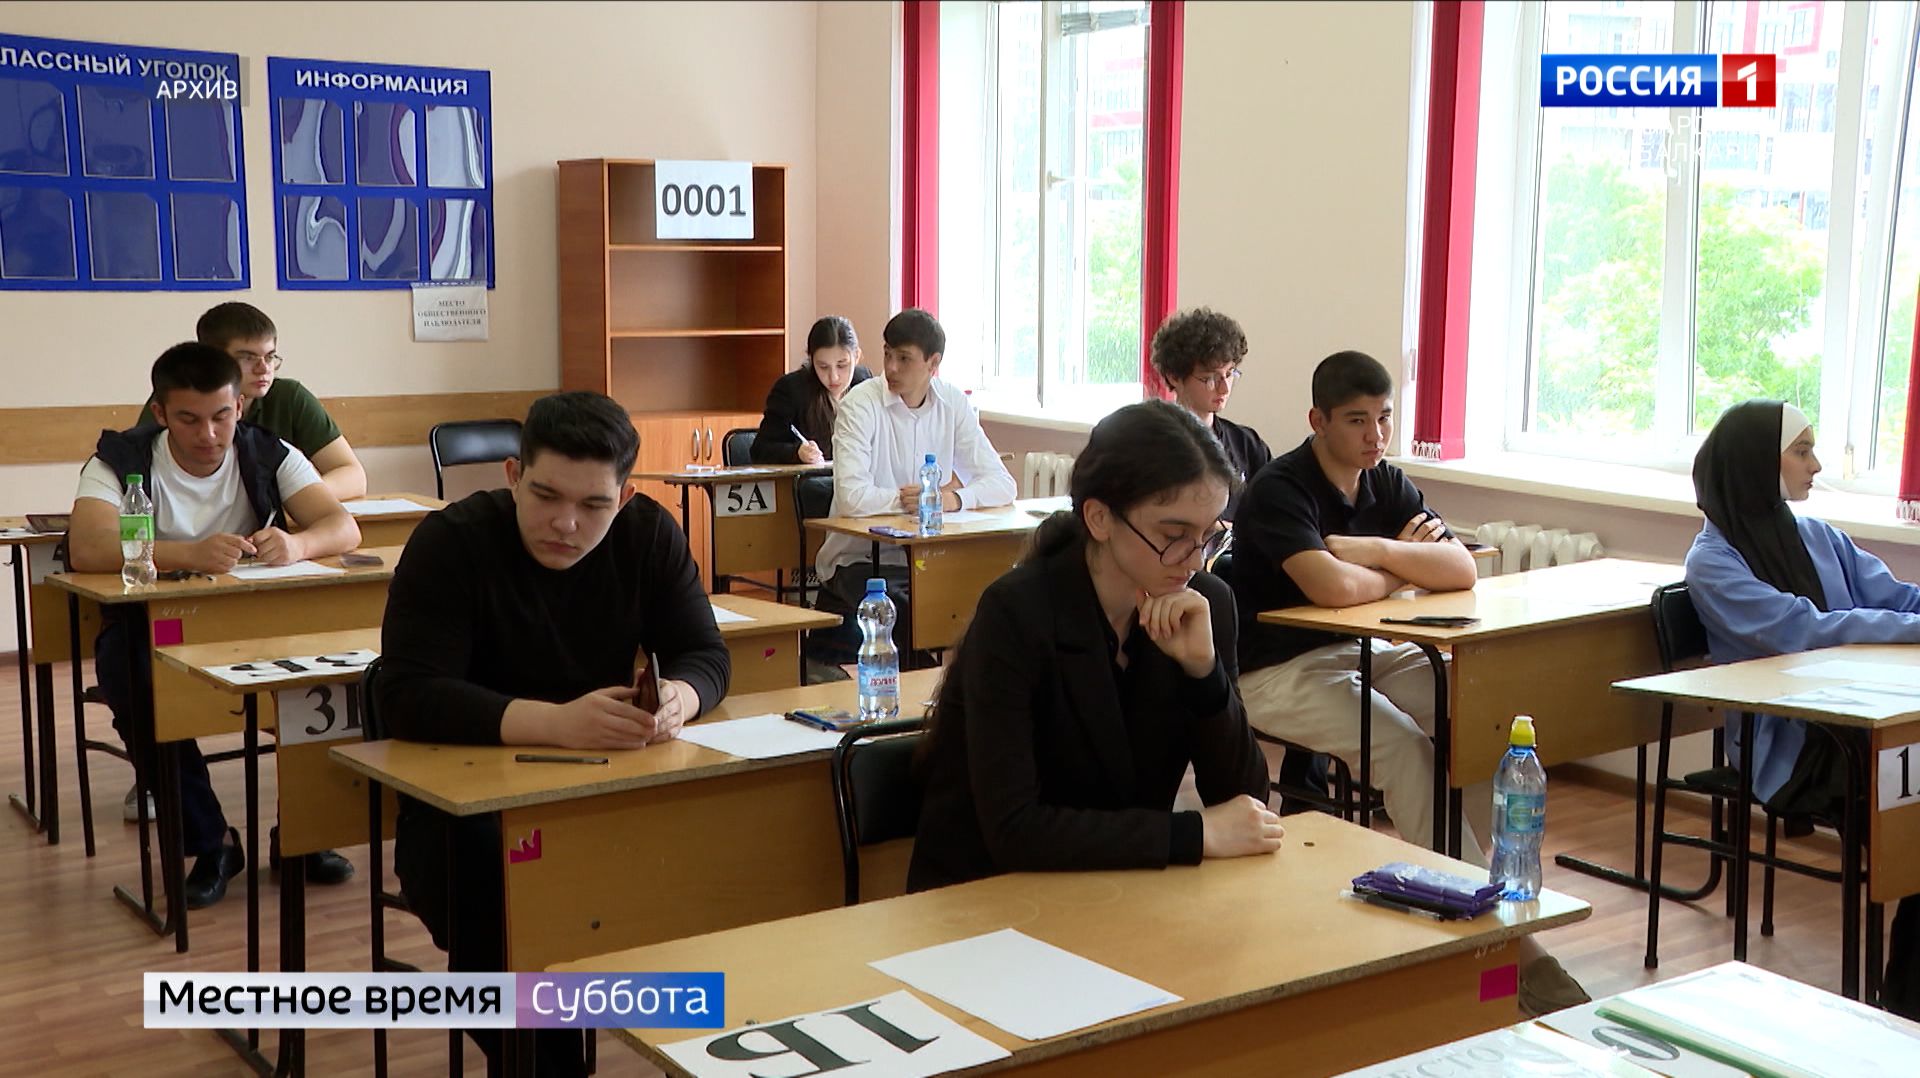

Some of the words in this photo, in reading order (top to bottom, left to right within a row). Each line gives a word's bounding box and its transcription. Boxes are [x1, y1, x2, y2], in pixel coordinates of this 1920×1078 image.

[138, 58, 229, 81] УГОЛОК
[296, 70, 468, 96] ИНФОРМАЦИЯ
[662, 184, 746, 217] 0001
[1896, 746, 1920, 801] 1
